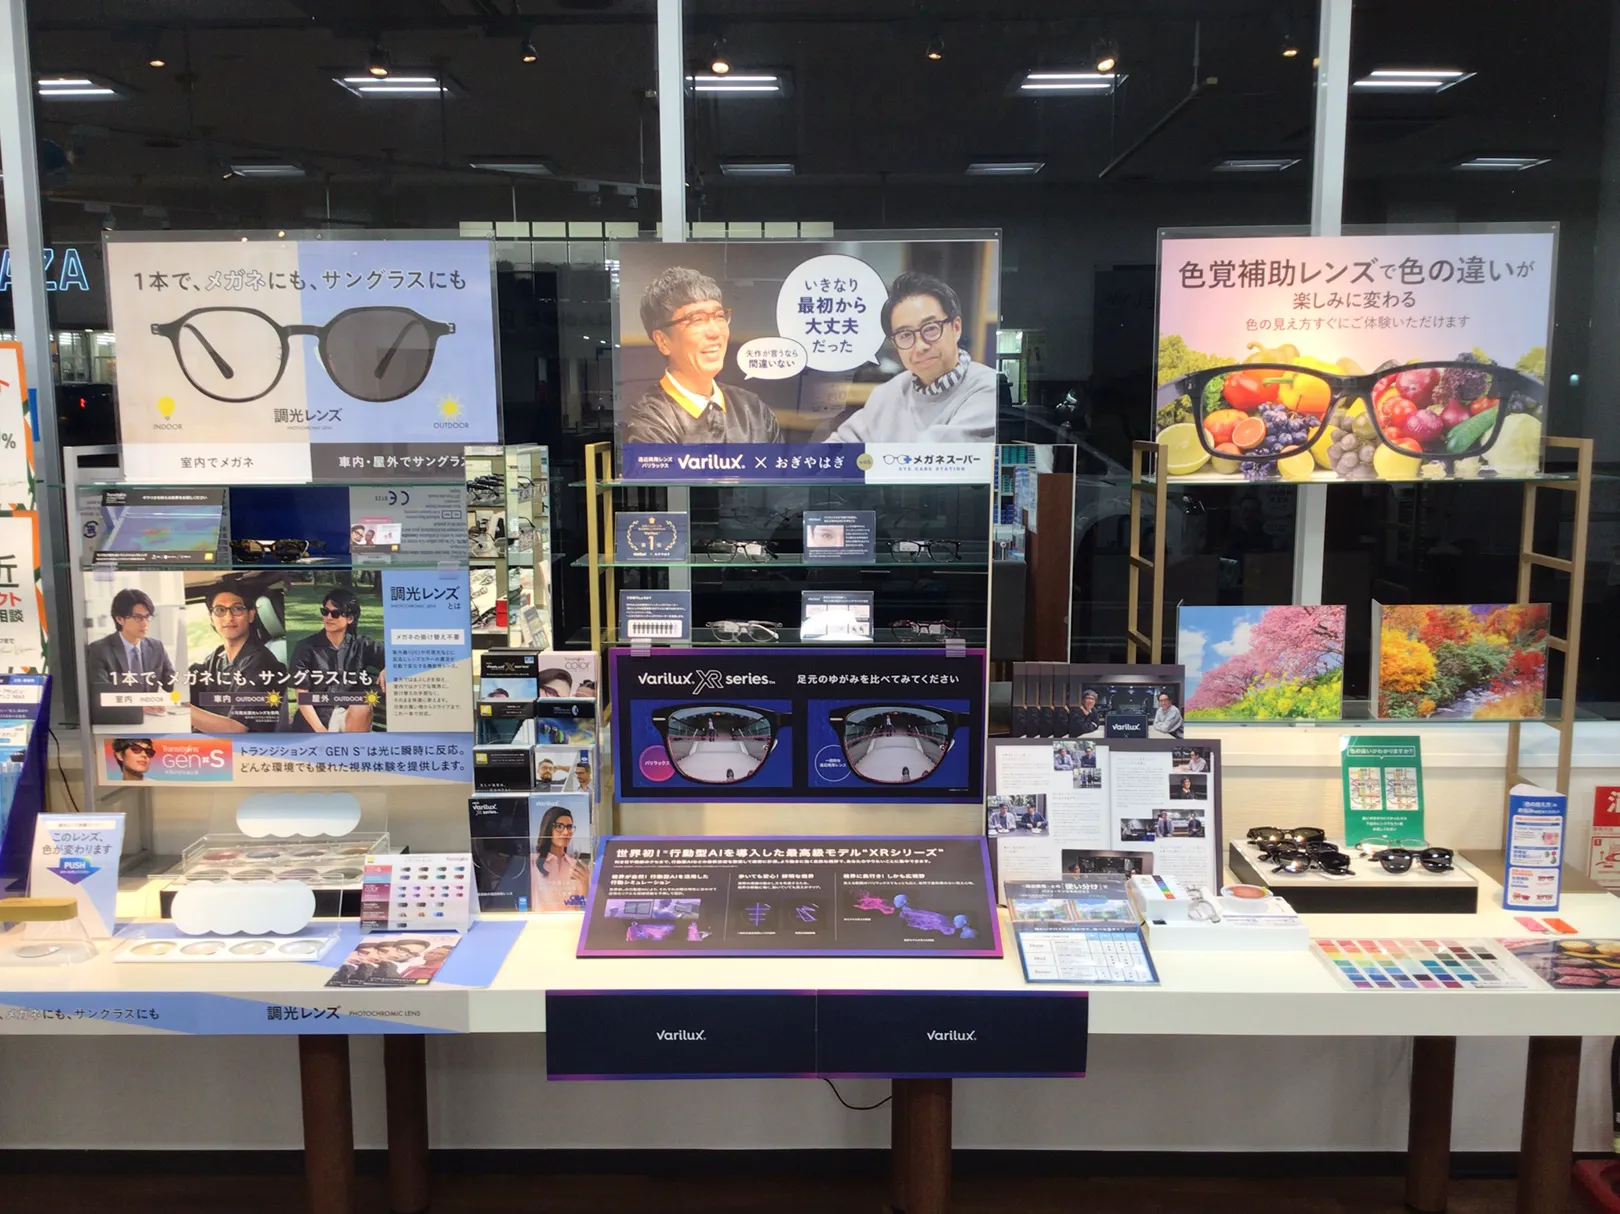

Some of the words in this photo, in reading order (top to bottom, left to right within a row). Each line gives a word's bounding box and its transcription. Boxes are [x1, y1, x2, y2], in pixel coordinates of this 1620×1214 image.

[1179, 255, 1535, 289] 色覚補助レンズで色の違いが
[133, 268, 467, 292] 1本で、メガネにも、サングラスにも
[804, 277, 859, 292] いきなり
[797, 297, 867, 314] 最初から
[1293, 291, 1416, 310] 楽しみに変わる
[805, 318, 859, 335] 大丈夫
[1245, 314, 1470, 331] 色の見え方すぐにご体験いただけます
[745, 349, 799, 358] 矢作が言うなら
[812, 339, 853, 354] だった
[748, 359, 795, 369] 間違いない
[273, 407, 343, 423] 調光レンズ
[180, 456, 254, 468] 室内でメガネ
[775, 456, 846, 470] おぎやはぎ
[913, 455, 980, 465] メガネスーパー
[390, 586, 460, 601] 調光レンズ
[109, 670, 374, 687] 1本で、メガネにも、サングラスにも
[796, 674, 960, 685] 足元のゆがみを比べてみてください
[115, 695, 133, 704] 室内
[326, 746, 348, 756] GEN
[240, 761, 465, 773] どんな環境でも優れた視界体験を提供します。
[52, 832, 104, 842] このレンズ、
[42, 844, 112, 855] 色が変わります
[64, 862, 86, 870] PUSH
[266, 1005, 342, 1020] 調光レンズ
